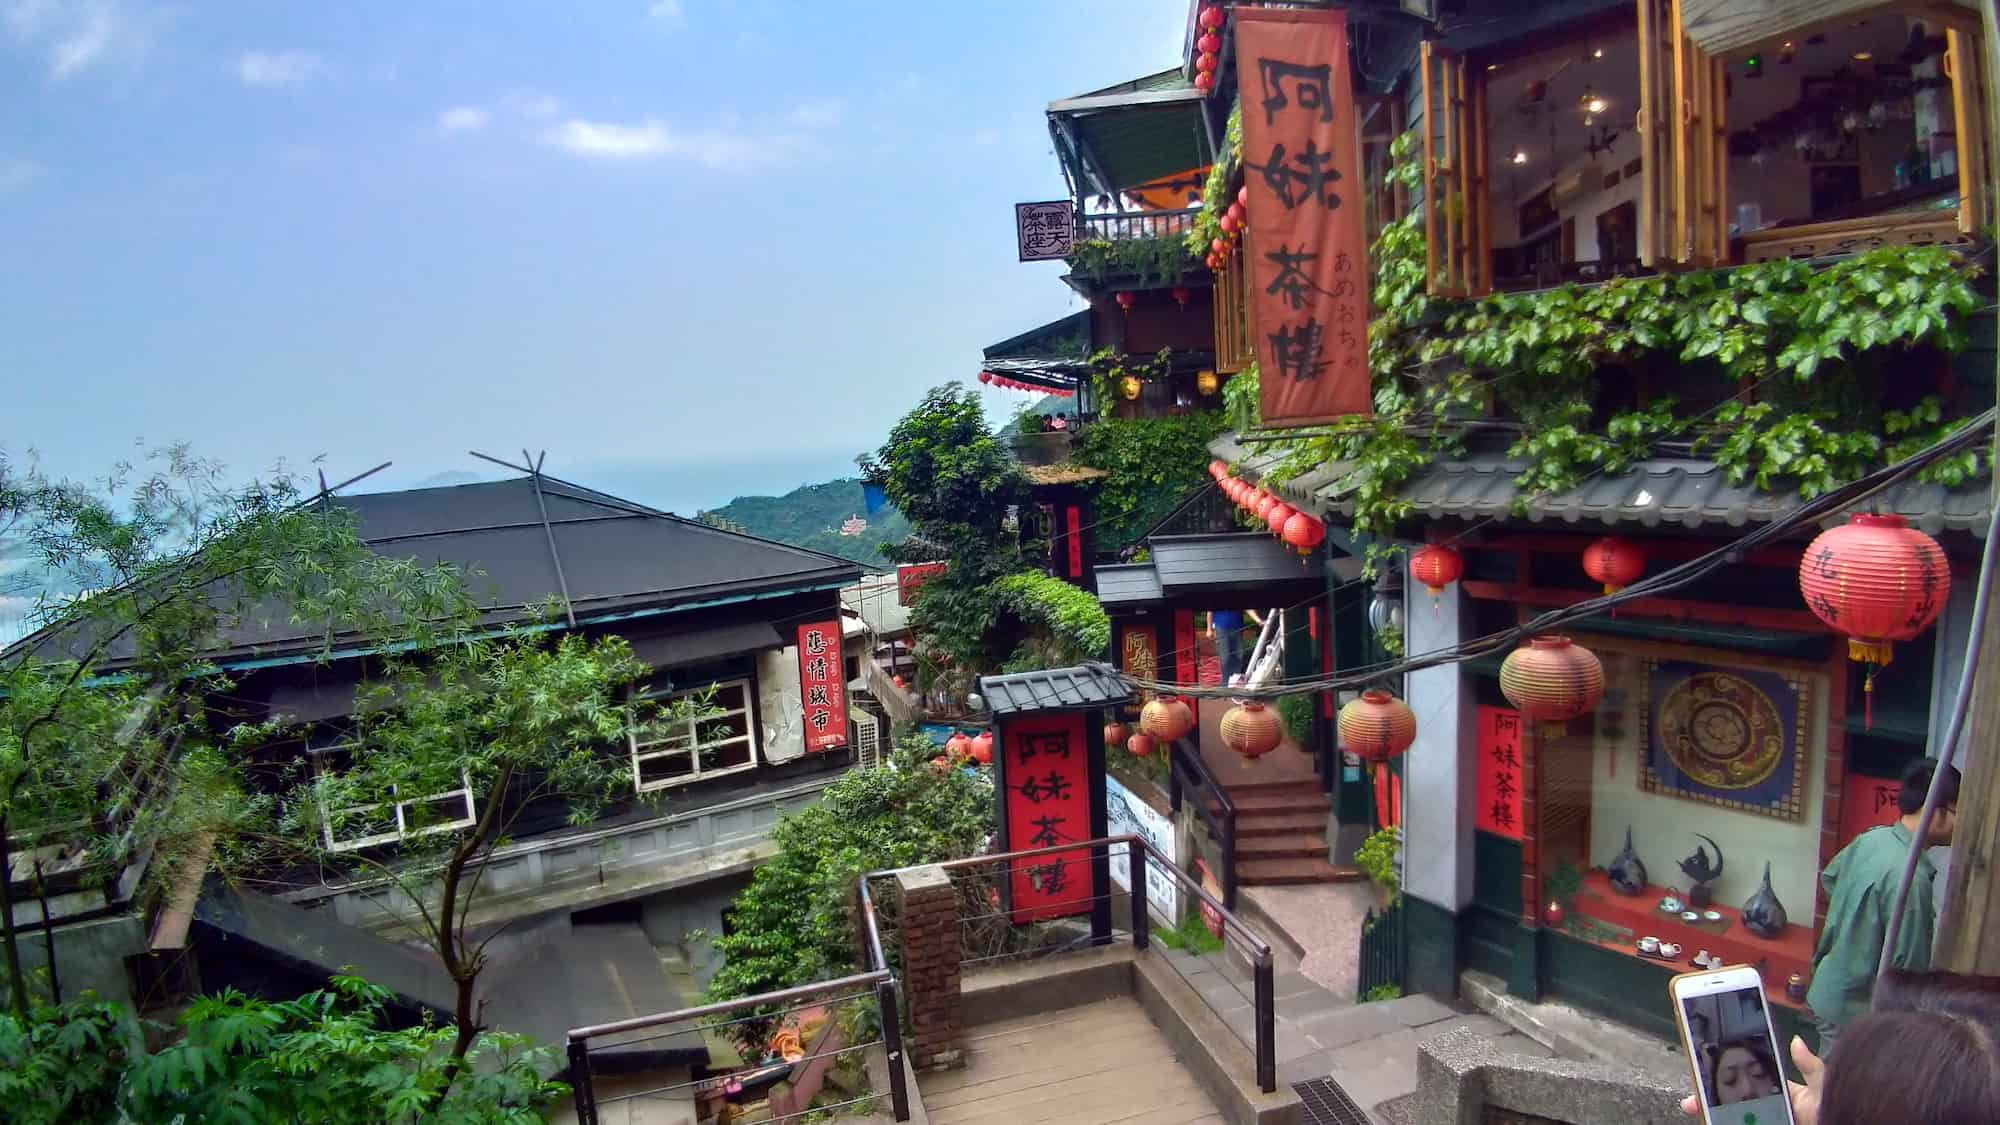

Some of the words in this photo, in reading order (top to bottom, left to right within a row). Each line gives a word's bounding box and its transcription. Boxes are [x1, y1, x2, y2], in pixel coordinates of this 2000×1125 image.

[1246, 57, 1341, 383] 阿妹茶樓
[804, 629, 832, 733] 悲情城市
[1008, 728, 1077, 896] 阿妹茶樓
[1490, 712, 1521, 832] 阿妹茶樓
